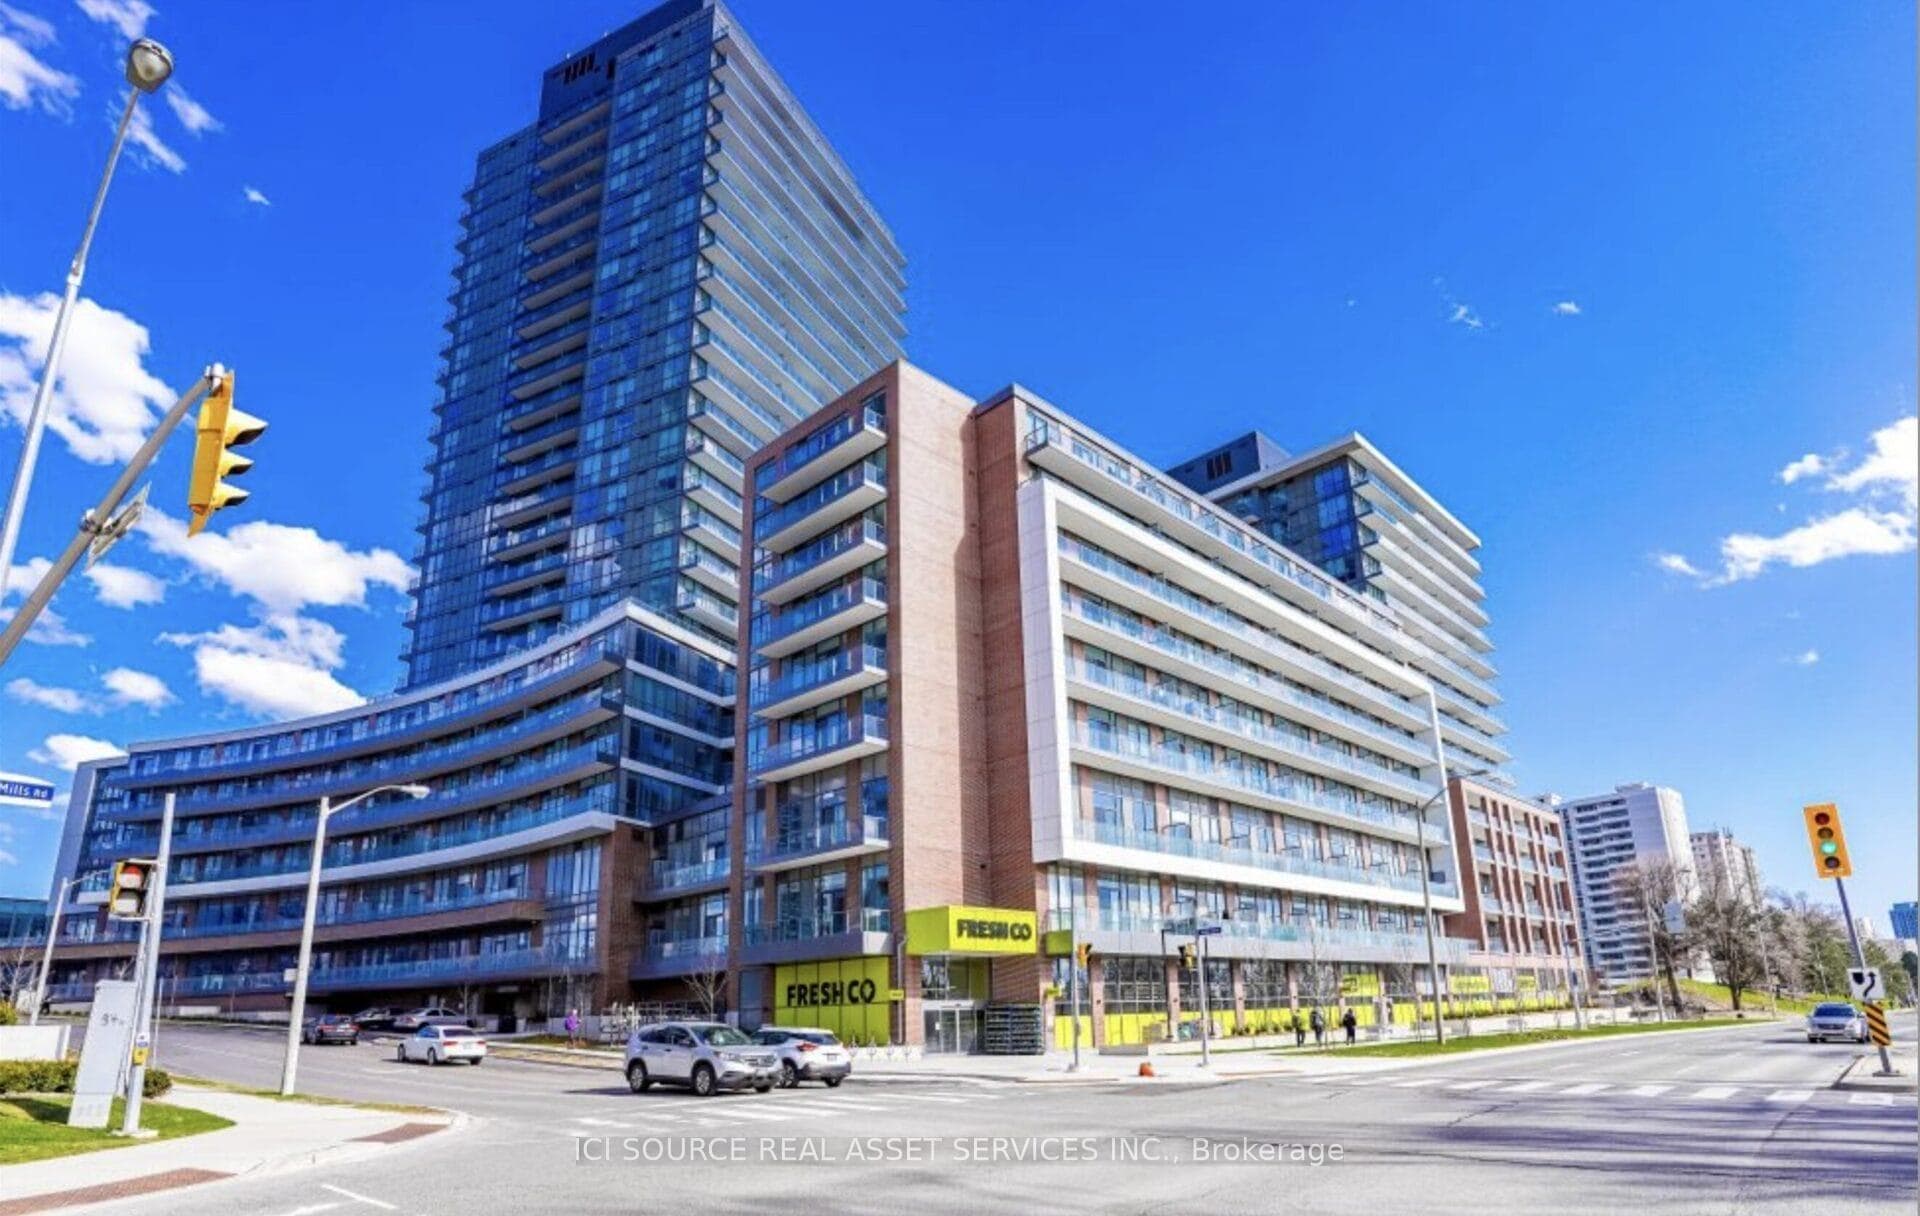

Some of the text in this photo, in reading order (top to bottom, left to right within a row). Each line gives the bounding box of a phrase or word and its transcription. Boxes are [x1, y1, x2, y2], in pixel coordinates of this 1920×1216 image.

[957, 919, 1008, 939] FRESH
[787, 978, 875, 1007] FRESH CO
